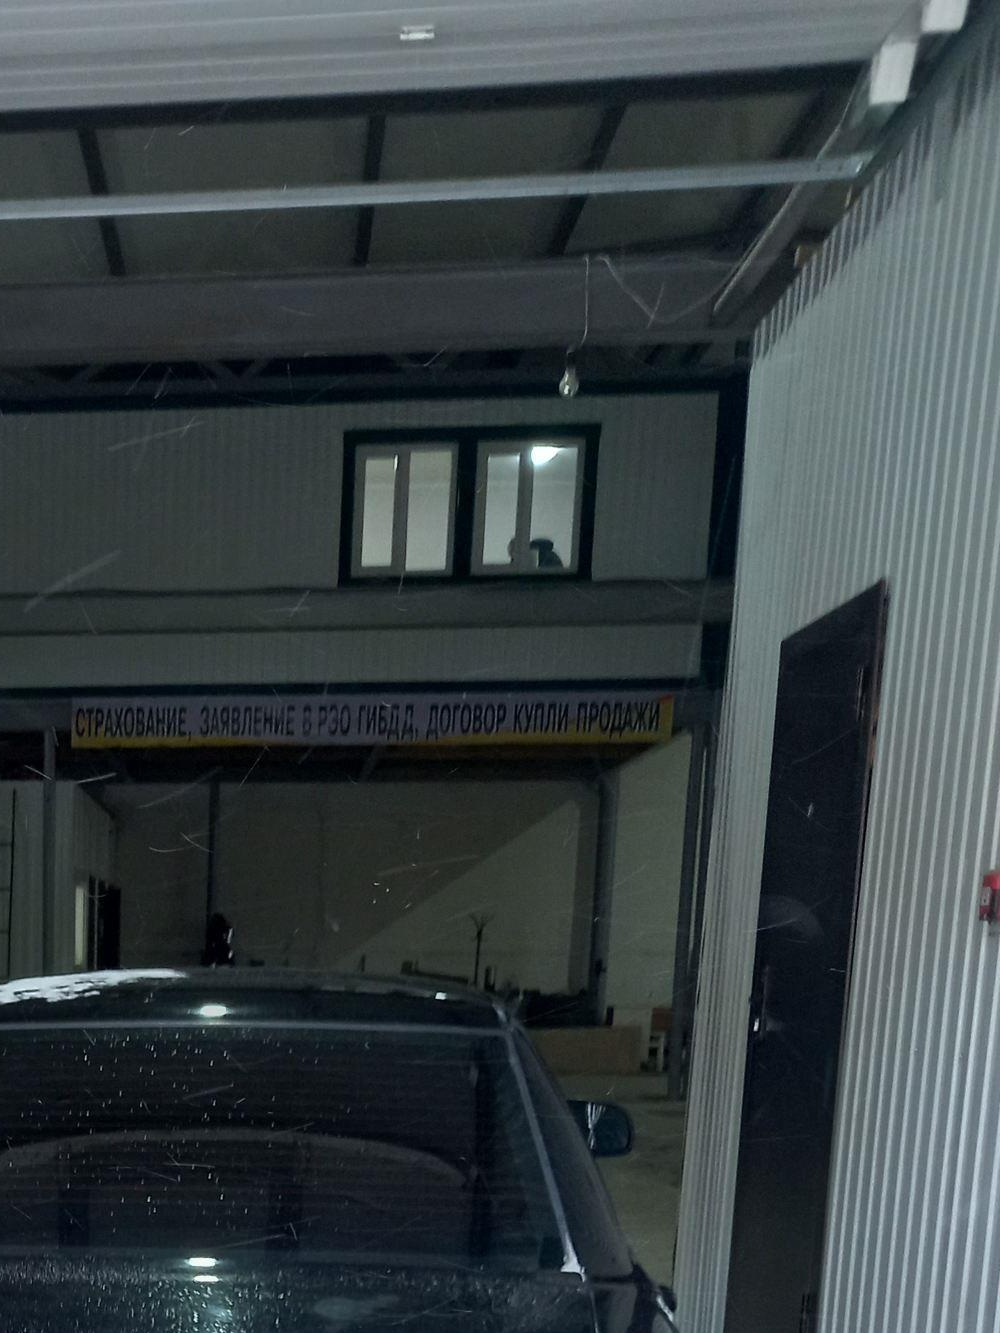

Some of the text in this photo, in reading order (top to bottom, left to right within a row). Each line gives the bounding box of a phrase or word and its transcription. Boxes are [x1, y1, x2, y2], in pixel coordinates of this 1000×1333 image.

[74, 706, 192, 740] СТРАХОВАНИЕ,
[200, 705, 296, 738] ЗАЯВЛЕНИЕ
[317, 705, 350, 736] РЭО
[357, 703, 418, 741] ГИБДД,
[426, 703, 507, 740] ДОГОВОР
[513, 702, 569, 734] КУПЛИ
[576, 702, 661, 738] ПРОДАЖИ
